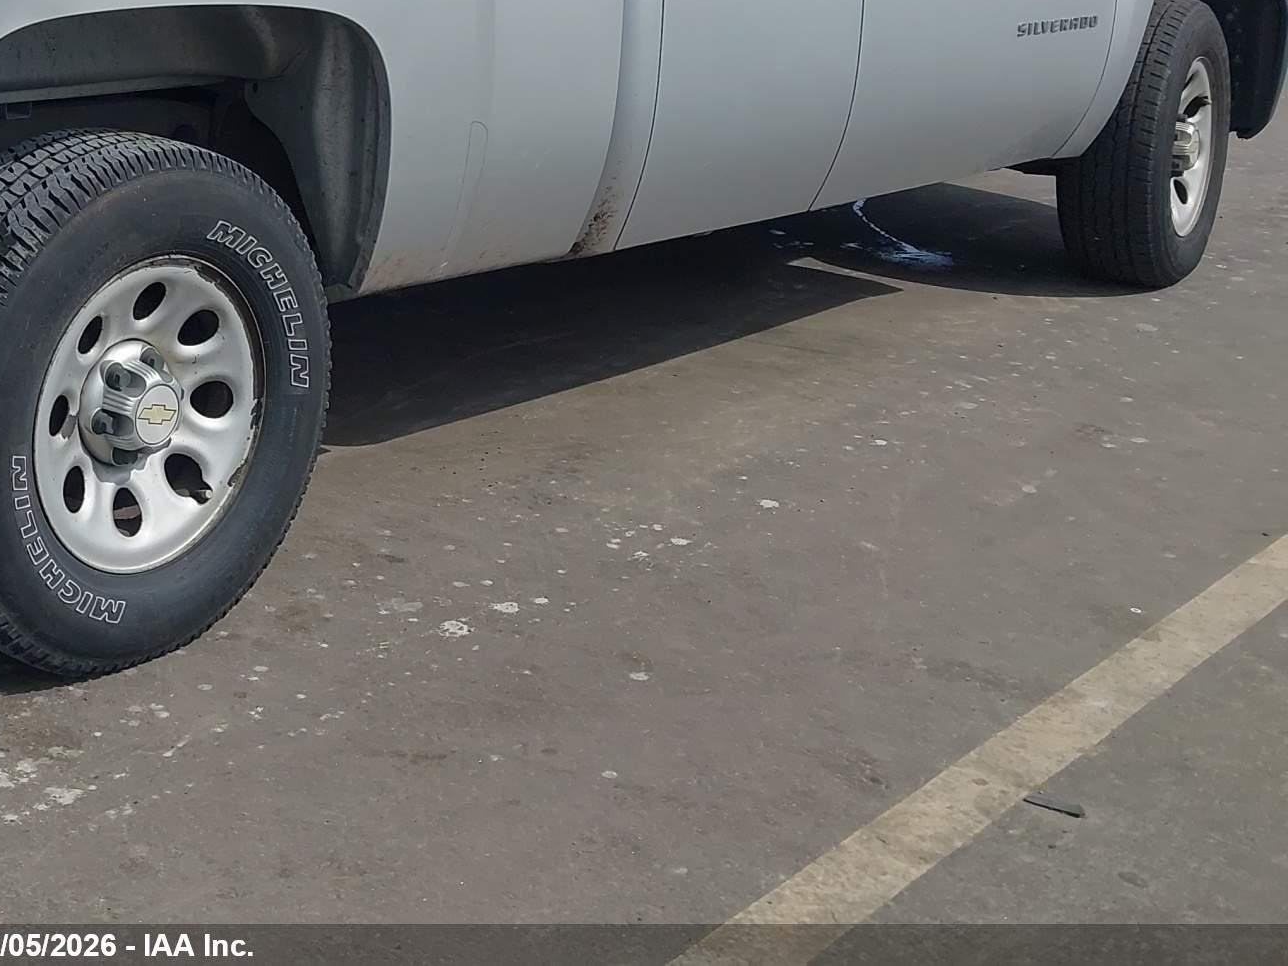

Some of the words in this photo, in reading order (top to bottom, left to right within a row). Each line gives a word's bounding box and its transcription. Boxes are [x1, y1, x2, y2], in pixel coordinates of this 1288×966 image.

[1016, 15, 1098, 38] SILVERADO
[206, 219, 310, 388] MICHELIN
[12, 455, 127, 624] MICHELIN
